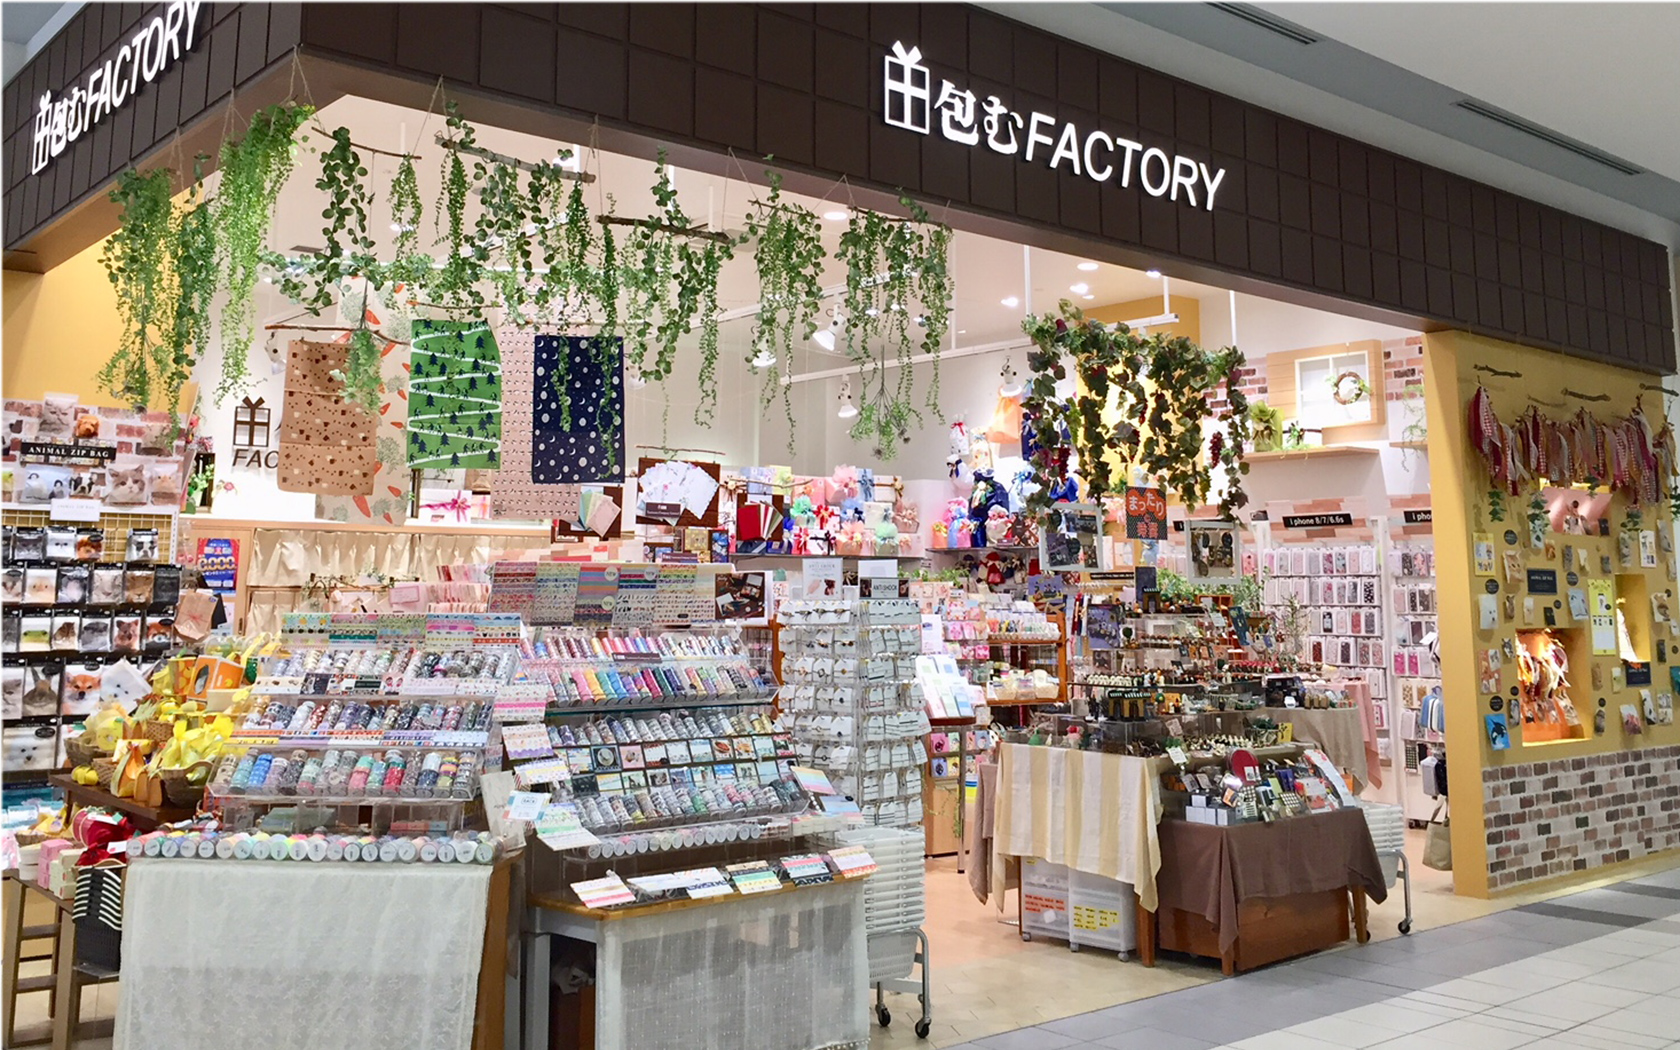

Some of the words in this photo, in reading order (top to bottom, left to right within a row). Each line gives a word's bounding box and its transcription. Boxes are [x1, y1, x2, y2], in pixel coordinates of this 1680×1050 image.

[28, 446, 67, 456] ANIMAL
[70, 449, 87, 457] ZIP
[89, 450, 109, 458] BAG
[1129, 492, 1165, 516] まったり
